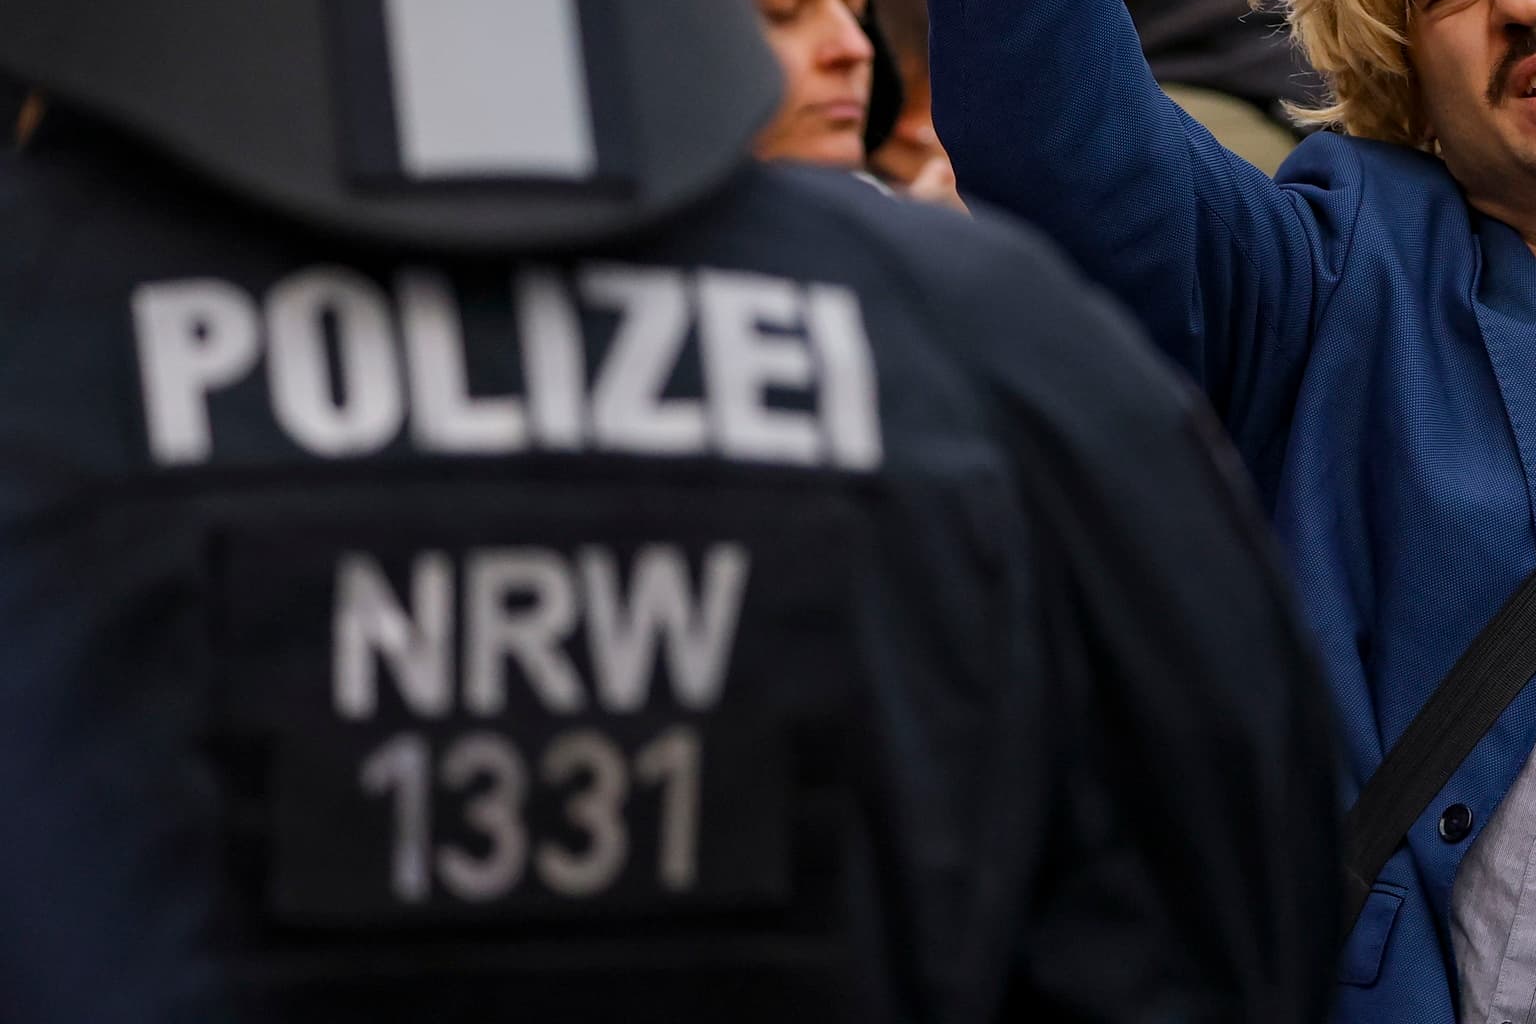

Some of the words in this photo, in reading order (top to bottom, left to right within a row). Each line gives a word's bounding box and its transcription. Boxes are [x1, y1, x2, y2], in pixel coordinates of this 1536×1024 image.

[130, 262, 886, 472] POLIZEI
[330, 539, 753, 722] NRW
[358, 724, 707, 905] 1331
